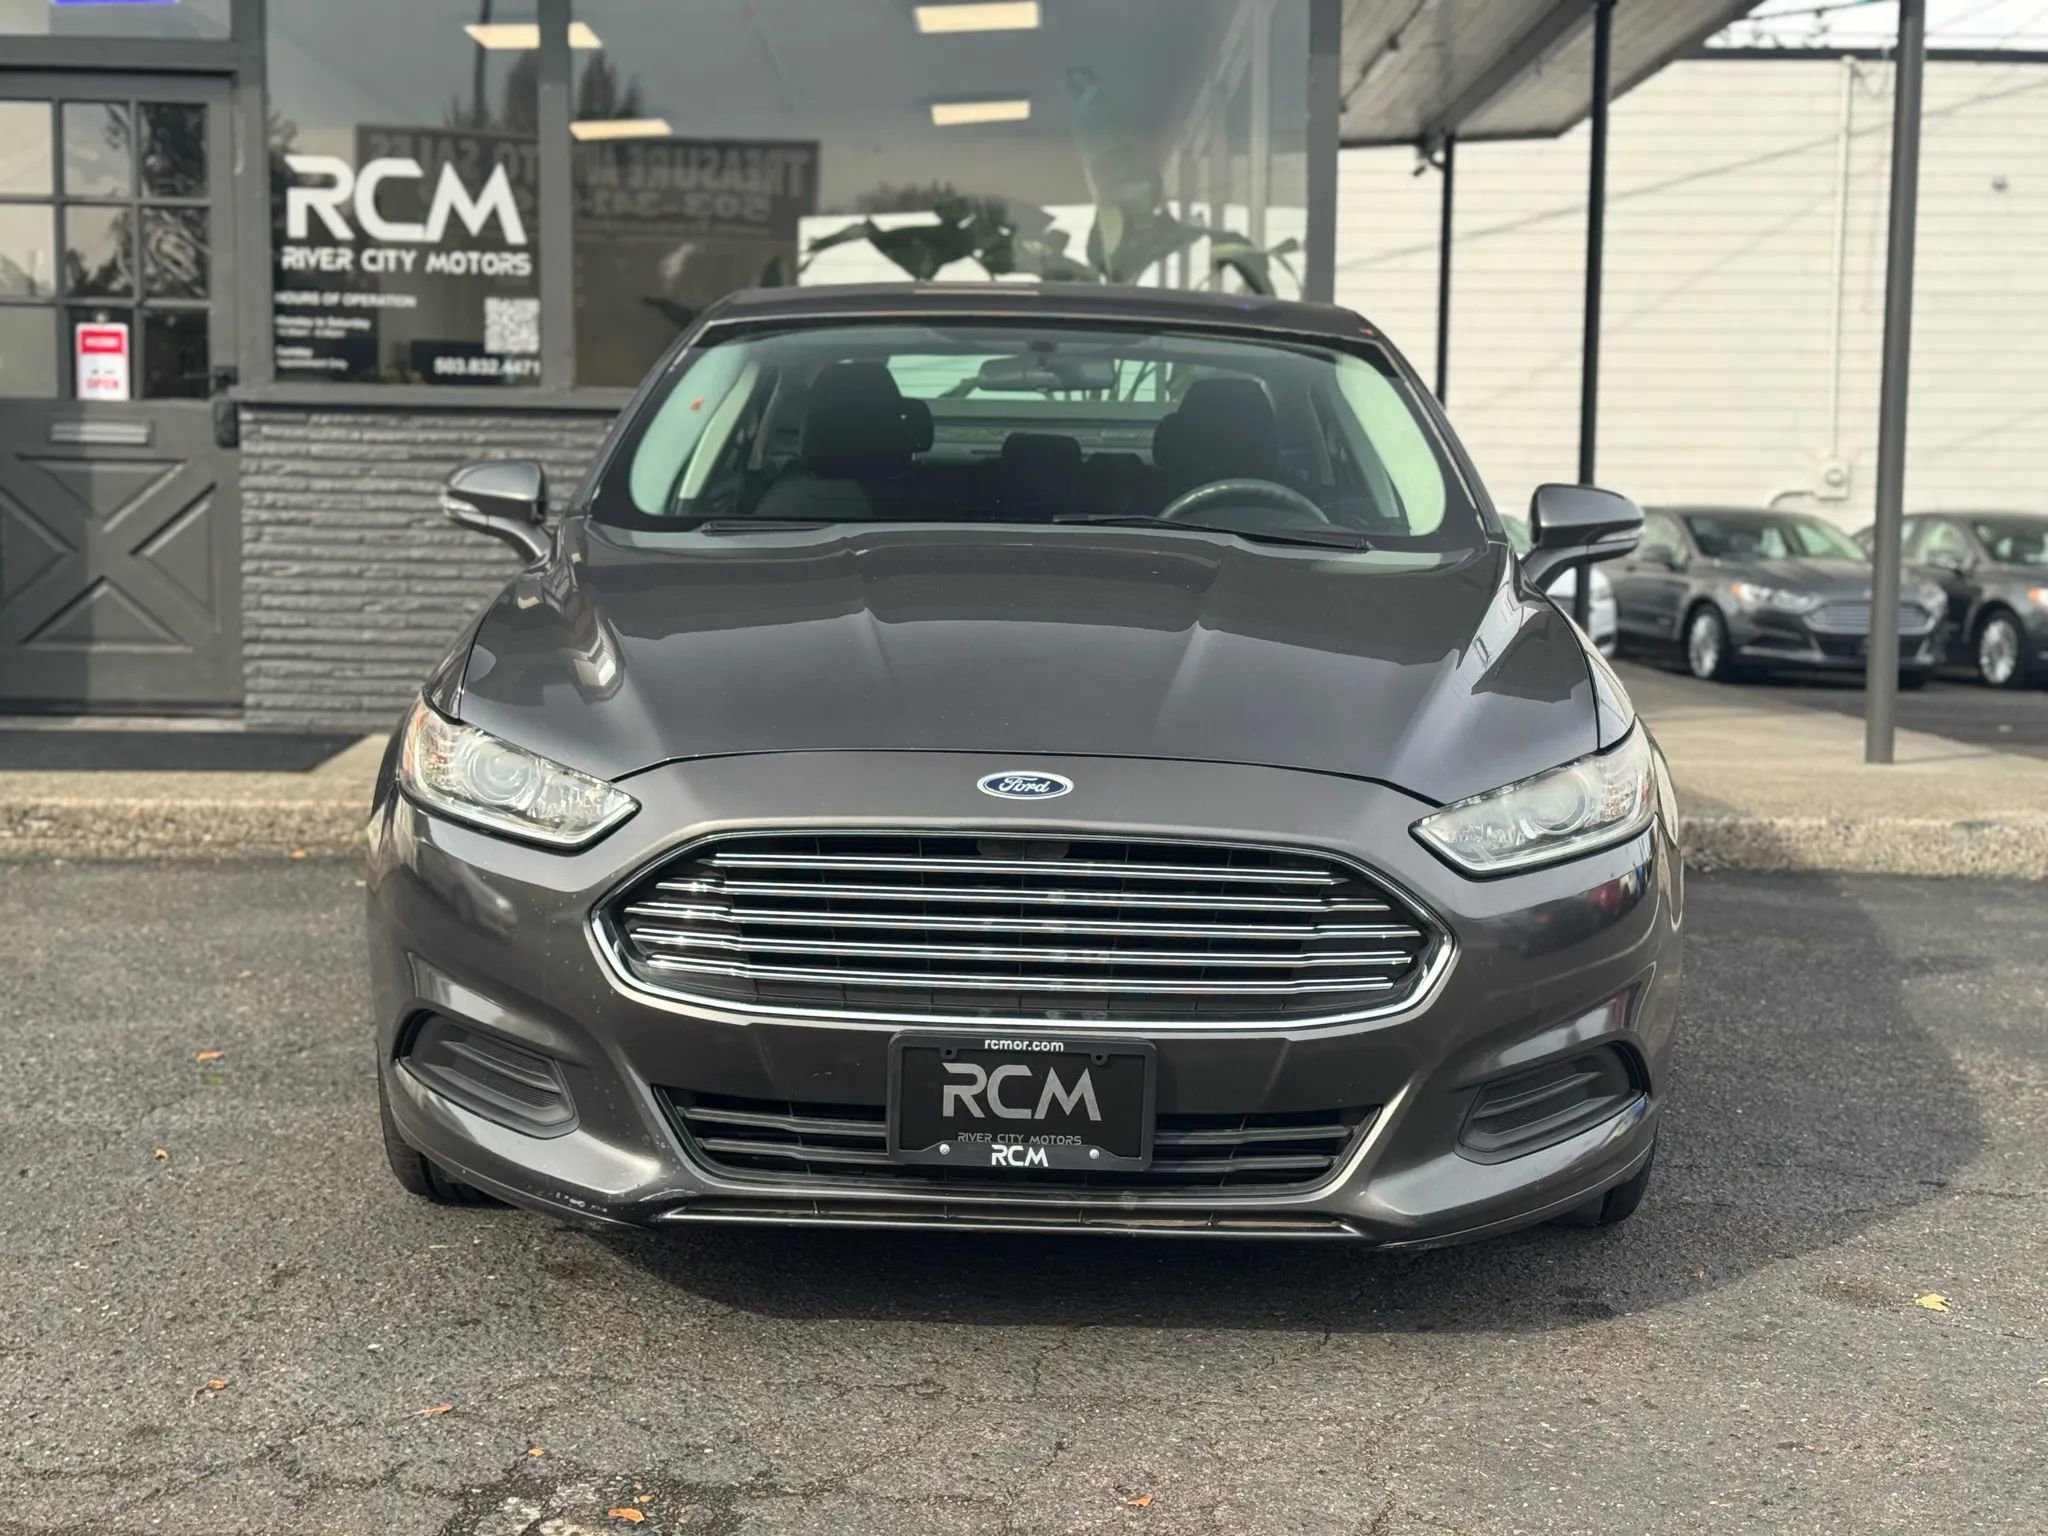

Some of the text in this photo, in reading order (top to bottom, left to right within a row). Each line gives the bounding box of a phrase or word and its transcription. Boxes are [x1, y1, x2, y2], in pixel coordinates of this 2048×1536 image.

[284, 155, 527, 245] RCM
[281, 246, 532, 276] RIVER CITY MOTORS
[998, 776, 1051, 793] Ford
[984, 1039, 1065, 1052] rcmor.com
[942, 1062, 1102, 1122] RCM
[957, 1132, 1083, 1146] RIVER CITY MOTORS
[991, 1144, 1049, 1168] RCM
